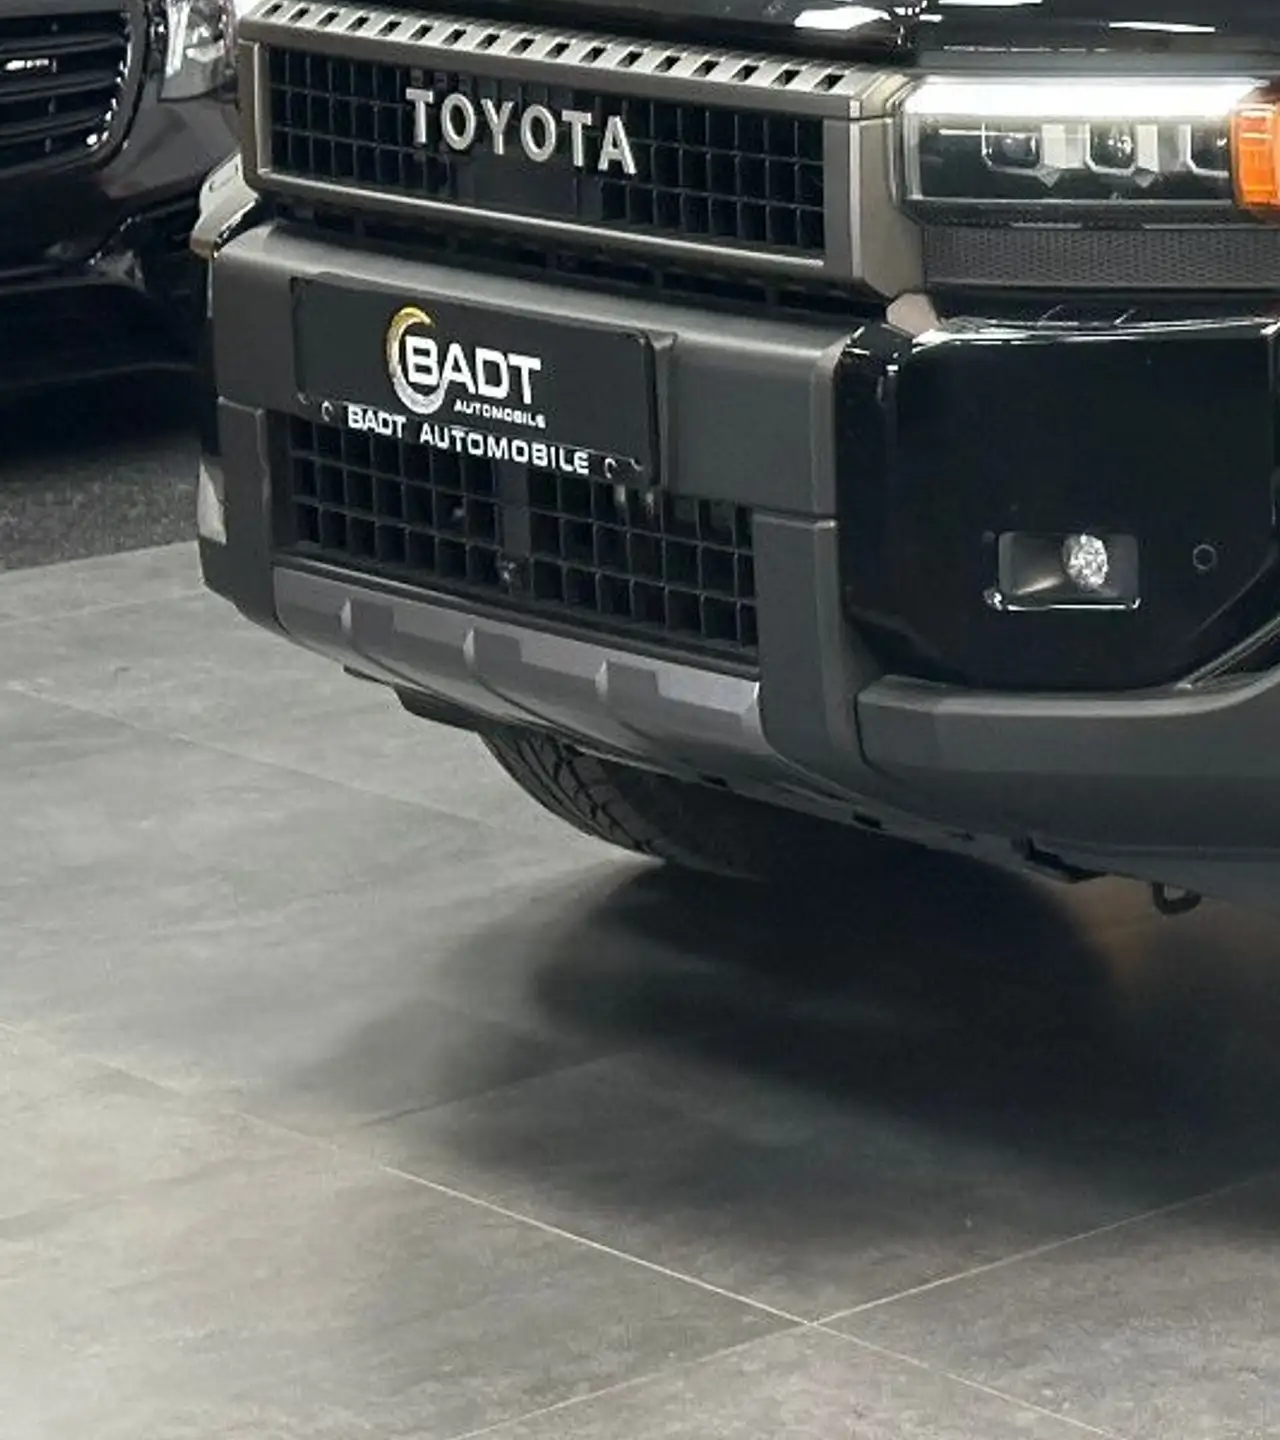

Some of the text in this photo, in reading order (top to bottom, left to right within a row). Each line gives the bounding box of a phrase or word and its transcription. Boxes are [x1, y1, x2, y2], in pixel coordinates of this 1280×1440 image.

[405, 88, 637, 174] TOYOTA
[405, 335, 541, 404] BADT
[348, 406, 589, 474] BADT AUTOMOBILE
[453, 398, 546, 428] AUTOMOBILE
